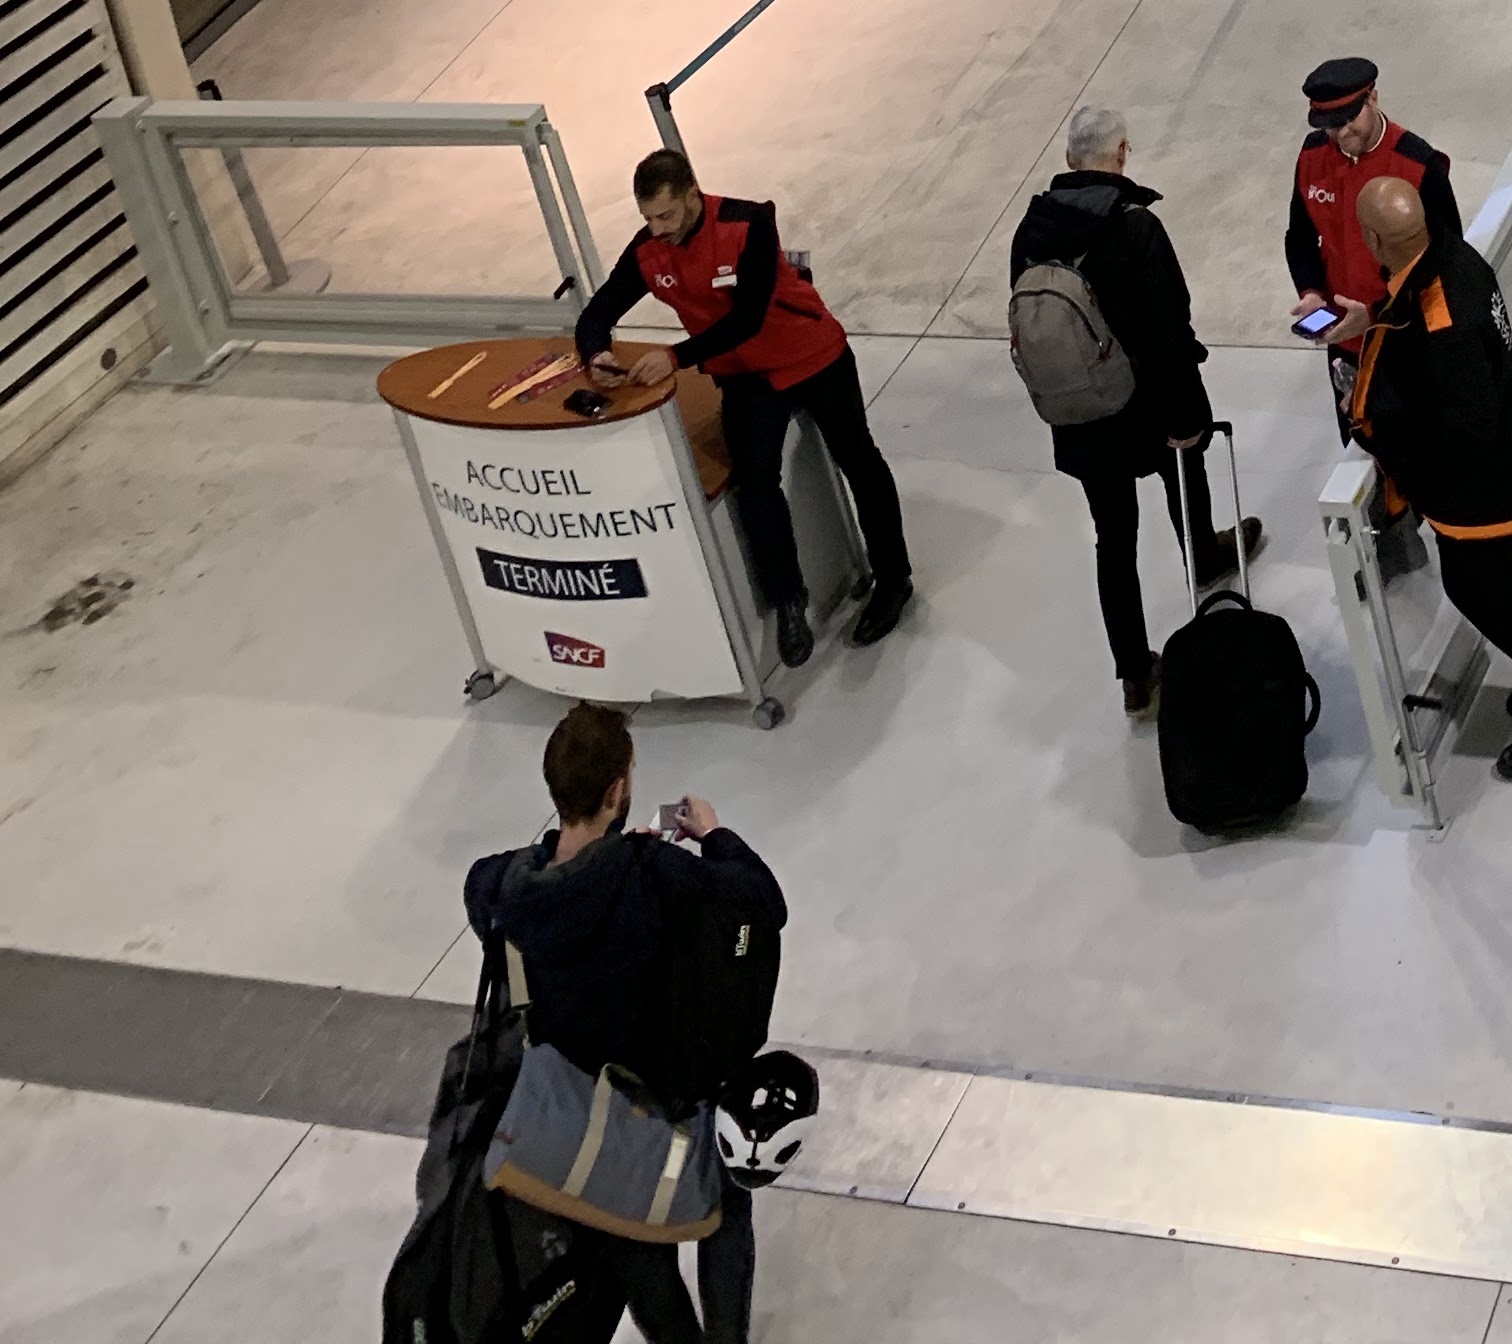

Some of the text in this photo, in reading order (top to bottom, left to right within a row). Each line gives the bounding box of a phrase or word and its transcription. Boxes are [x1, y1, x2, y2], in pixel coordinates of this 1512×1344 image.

[467, 460, 592, 496] ACCUEIL
[431, 482, 676, 539] EMBARQUEMENT
[493, 559, 620, 596] TERMINÉ
[552, 643, 599, 664] SNCF
